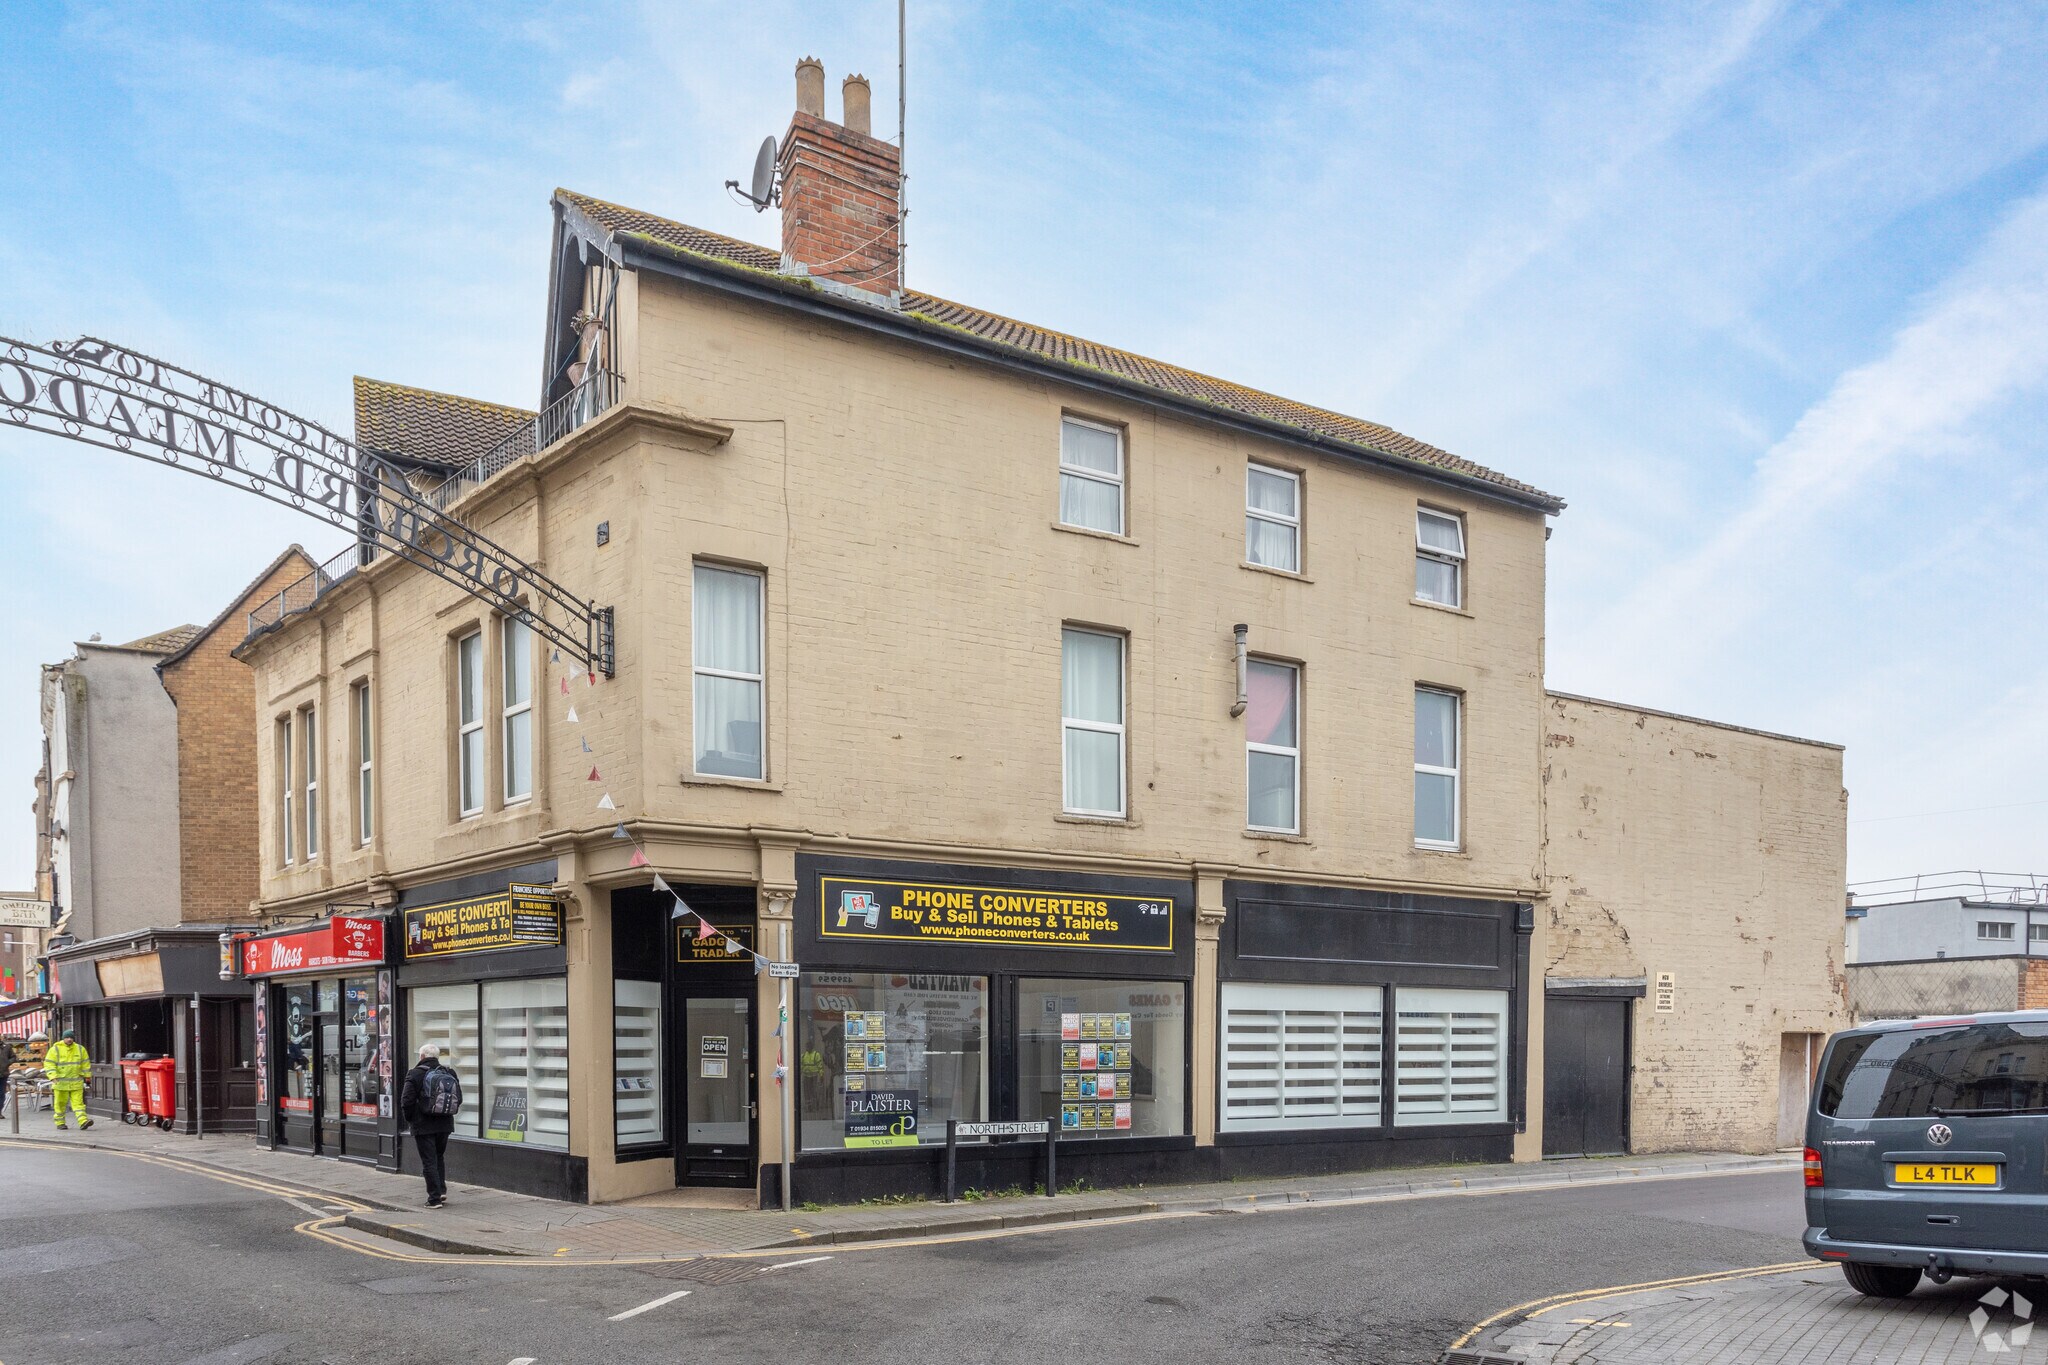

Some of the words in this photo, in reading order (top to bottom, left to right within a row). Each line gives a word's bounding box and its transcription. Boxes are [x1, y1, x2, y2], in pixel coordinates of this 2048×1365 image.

[2, 902, 46, 912] OMELETTE
[903, 890, 974, 910] PHONE
[980, 895, 1108, 916] CONVERTERS
[425, 911, 457, 927] PHONE
[459, 900, 510, 922] CONVERT
[891, 906, 924, 924] Buy
[929, 909, 940, 921] &
[947, 909, 978, 924] Sell
[983, 912, 1041, 926] Phones
[1046, 915, 1058, 928] &
[1062, 916, 1119, 931] Tablets
[345, 920, 372, 930] Moss
[422, 929, 436, 942] Buy
[437, 926, 444, 937] &
[445, 924, 459, 936] Sell
[460, 921, 489, 934] Phones
[491, 918, 498, 930] &
[920, 925, 1090, 941] www.phoneconverters.co.uk
[692, 937, 740, 946] GADGT
[271, 940, 303, 969] Moss
[496, 1097, 526, 1108] PLAISTER
[851, 1100, 912, 1112] PLAISTER
[970, 1124, 1005, 1134] NORTH
[1009, 1123, 1045, 1133] STREET
[1914, 1168, 1935, 1180] L4
[1941, 1168, 1976, 1181] TLK
